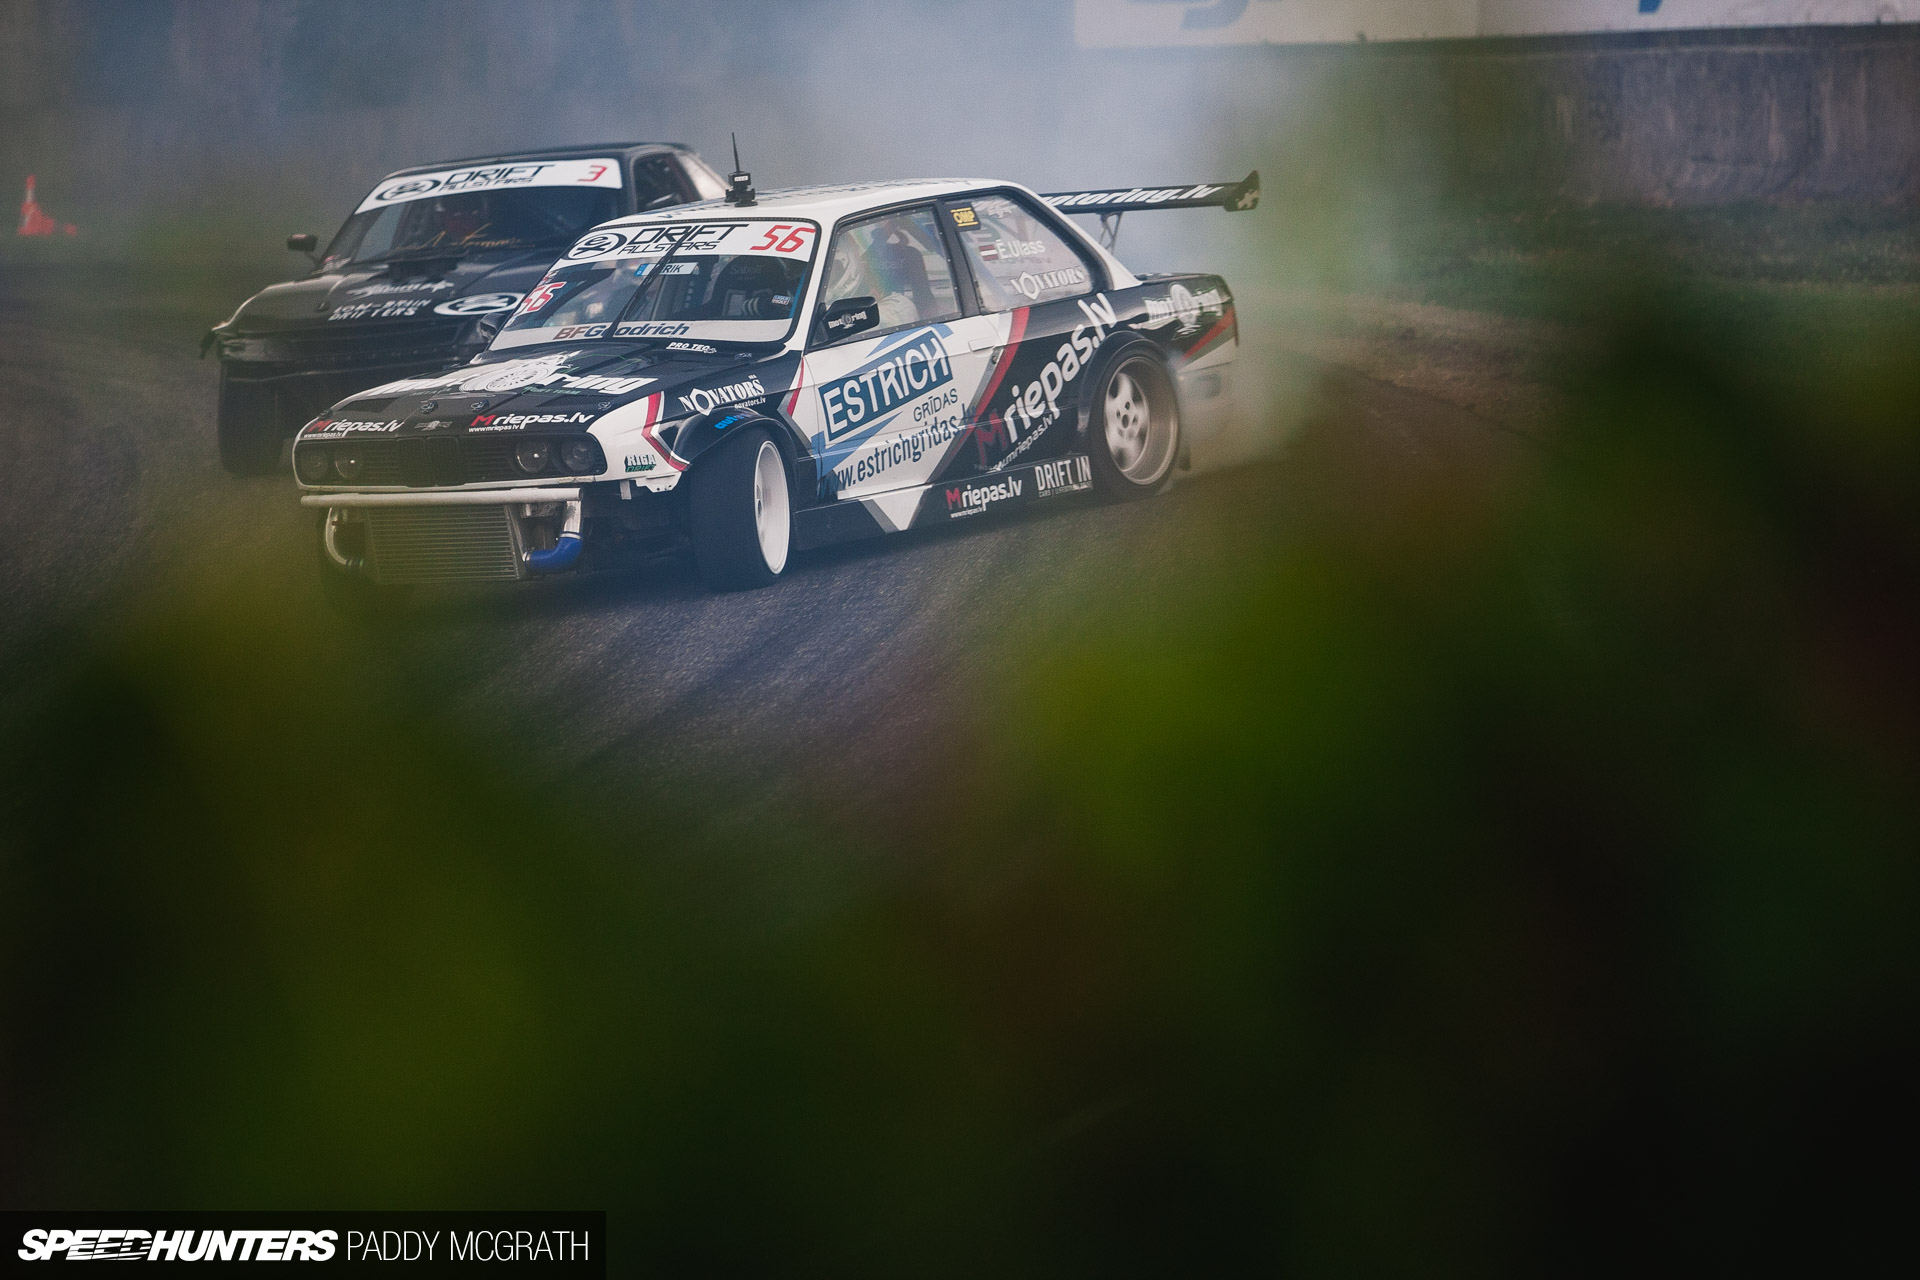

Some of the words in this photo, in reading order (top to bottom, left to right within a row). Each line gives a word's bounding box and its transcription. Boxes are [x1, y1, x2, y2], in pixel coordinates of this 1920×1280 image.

[446, 164, 554, 186] DRIFT
[577, 165, 607, 182] 3
[438, 176, 535, 192] ALLSTARS
[1044, 184, 1224, 206] otoring.lv
[953, 211, 976, 223] OMP
[625, 224, 749, 245] DRIFT
[750, 225, 815, 253] 56
[617, 240, 720, 255] ALLSTARS
[662, 264, 684, 274] RIK
[553, 322, 690, 340] BFGodrich
[668, 341, 690, 350] PRO
[823, 337, 949, 433] ESTRICH
[975, 292, 1118, 468] Mriepas.lv
[678, 379, 764, 416] NOVATORS
[308, 419, 404, 437] Mriepas.lv
[470, 412, 594, 429] Mriepas.lv
[819, 403, 977, 495] w.estrichgridas.lv
[625, 455, 656, 466] RIGA
[1034, 459, 1073, 491] DRIFT
[1075, 456, 1092, 483] IN
[946, 476, 1022, 511] Mriepas.lv
